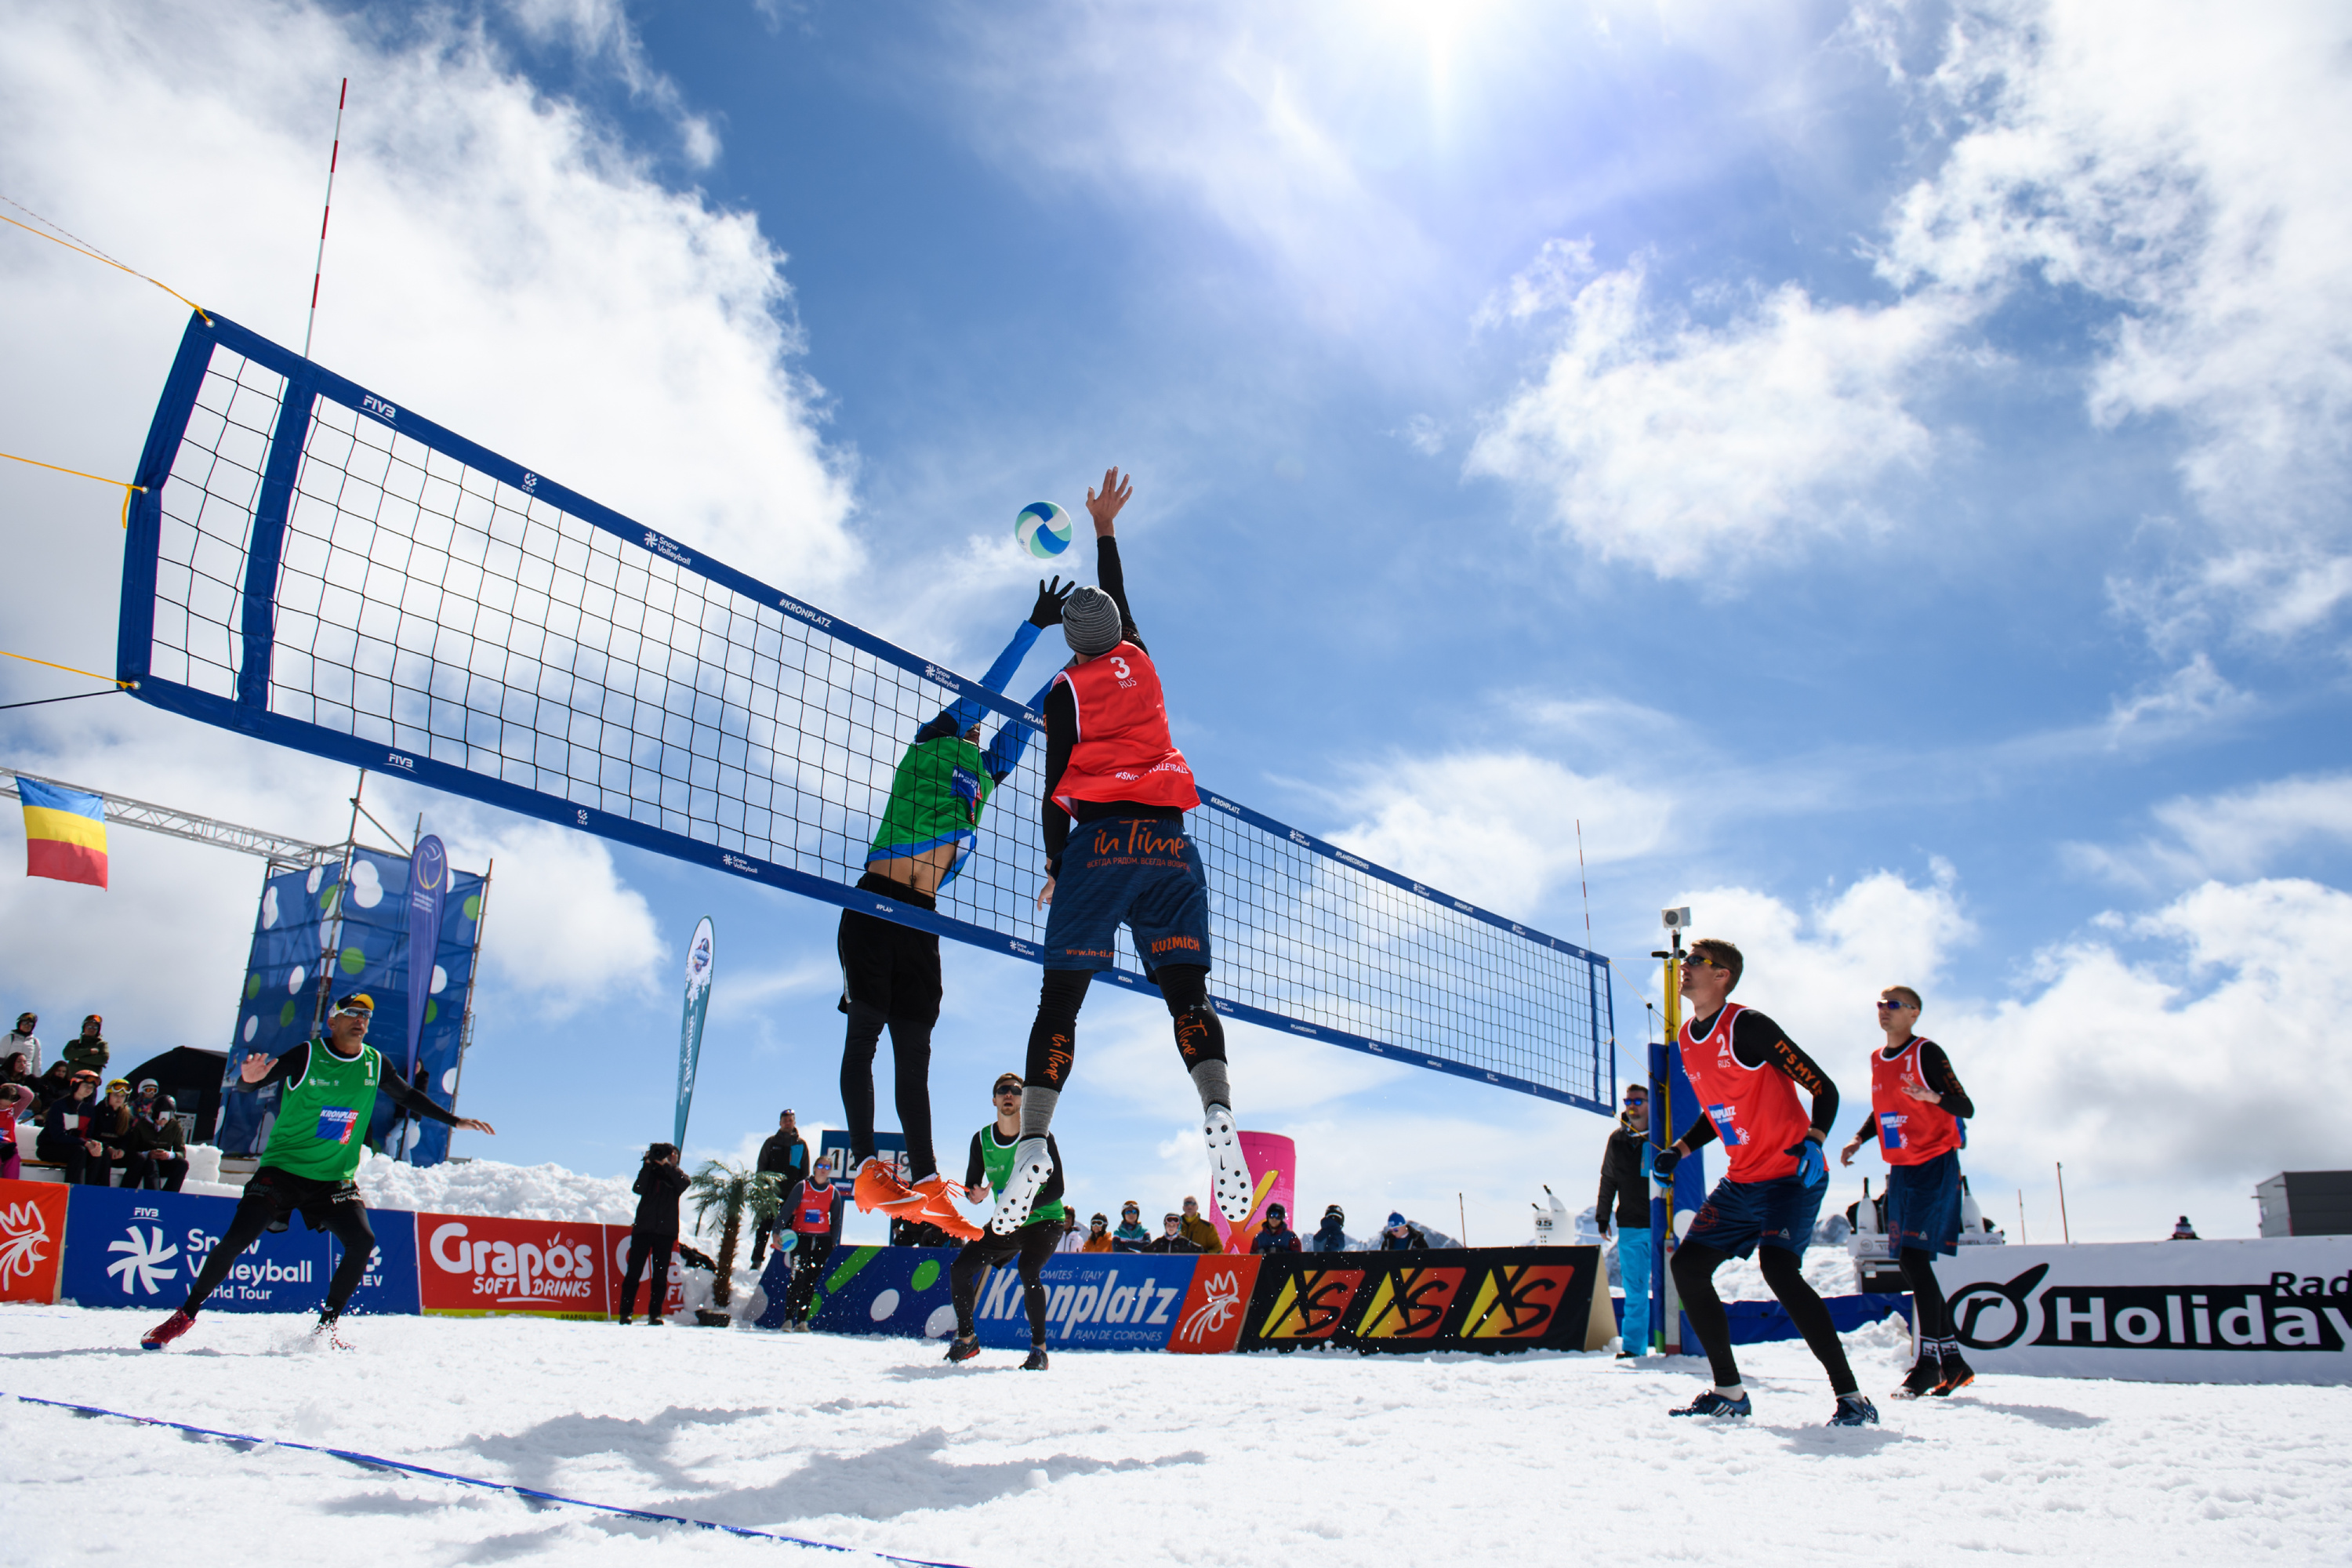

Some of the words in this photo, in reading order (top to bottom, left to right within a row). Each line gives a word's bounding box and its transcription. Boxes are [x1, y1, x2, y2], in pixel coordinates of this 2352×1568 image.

[363, 394, 396, 418] FIVB
[521, 485, 535, 494] CEV
[659, 536, 679, 551] Snow
[657, 544, 691, 565] Volleyball
[779, 598, 832, 628] #KRONPLATZ
[936, 666, 950, 679] Snow
[1110, 656, 1131, 679] 3
[935, 673, 960, 691] Volleyball
[1118, 677, 1137, 689] RUS
[389, 753, 413, 768] FIVB
[1210, 796, 1240, 815] #KRONPLATZ
[732, 855, 748, 865] Snow
[733, 861, 758, 874] Volleyball
[1152, 935, 1201, 954] KUZMICH
[1716, 1033, 1730, 1057] 2
[1718, 1058, 1731, 1069] RUS
[1774, 1039, 1798, 1065] IT'S
[1795, 1062, 1817, 1082] MY
[1904, 1054, 1913, 1073] 1
[365, 1061, 374, 1078] 1
[364, 1078, 376, 1087] BRA
[1900, 1073, 1915, 1082] RUS
[320, 1109, 359, 1120] KRONPLATZ
[134, 1207, 159, 1218] FIVB
[187, 1228, 260, 1254] Snw
[187, 1254, 312, 1287] Vleyball
[1081, 1271, 1105, 1279] ITALY
[358, 1274, 383, 1287] EV
[473, 1276, 517, 1294] SOFT
[532, 1279, 592, 1298] DRINKS
[238, 1286, 273, 1300] Tour
[1074, 1329, 1097, 1339] PLAN
[1098, 1330, 1112, 1340] DE
[1113, 1330, 1163, 1341] CORONES
